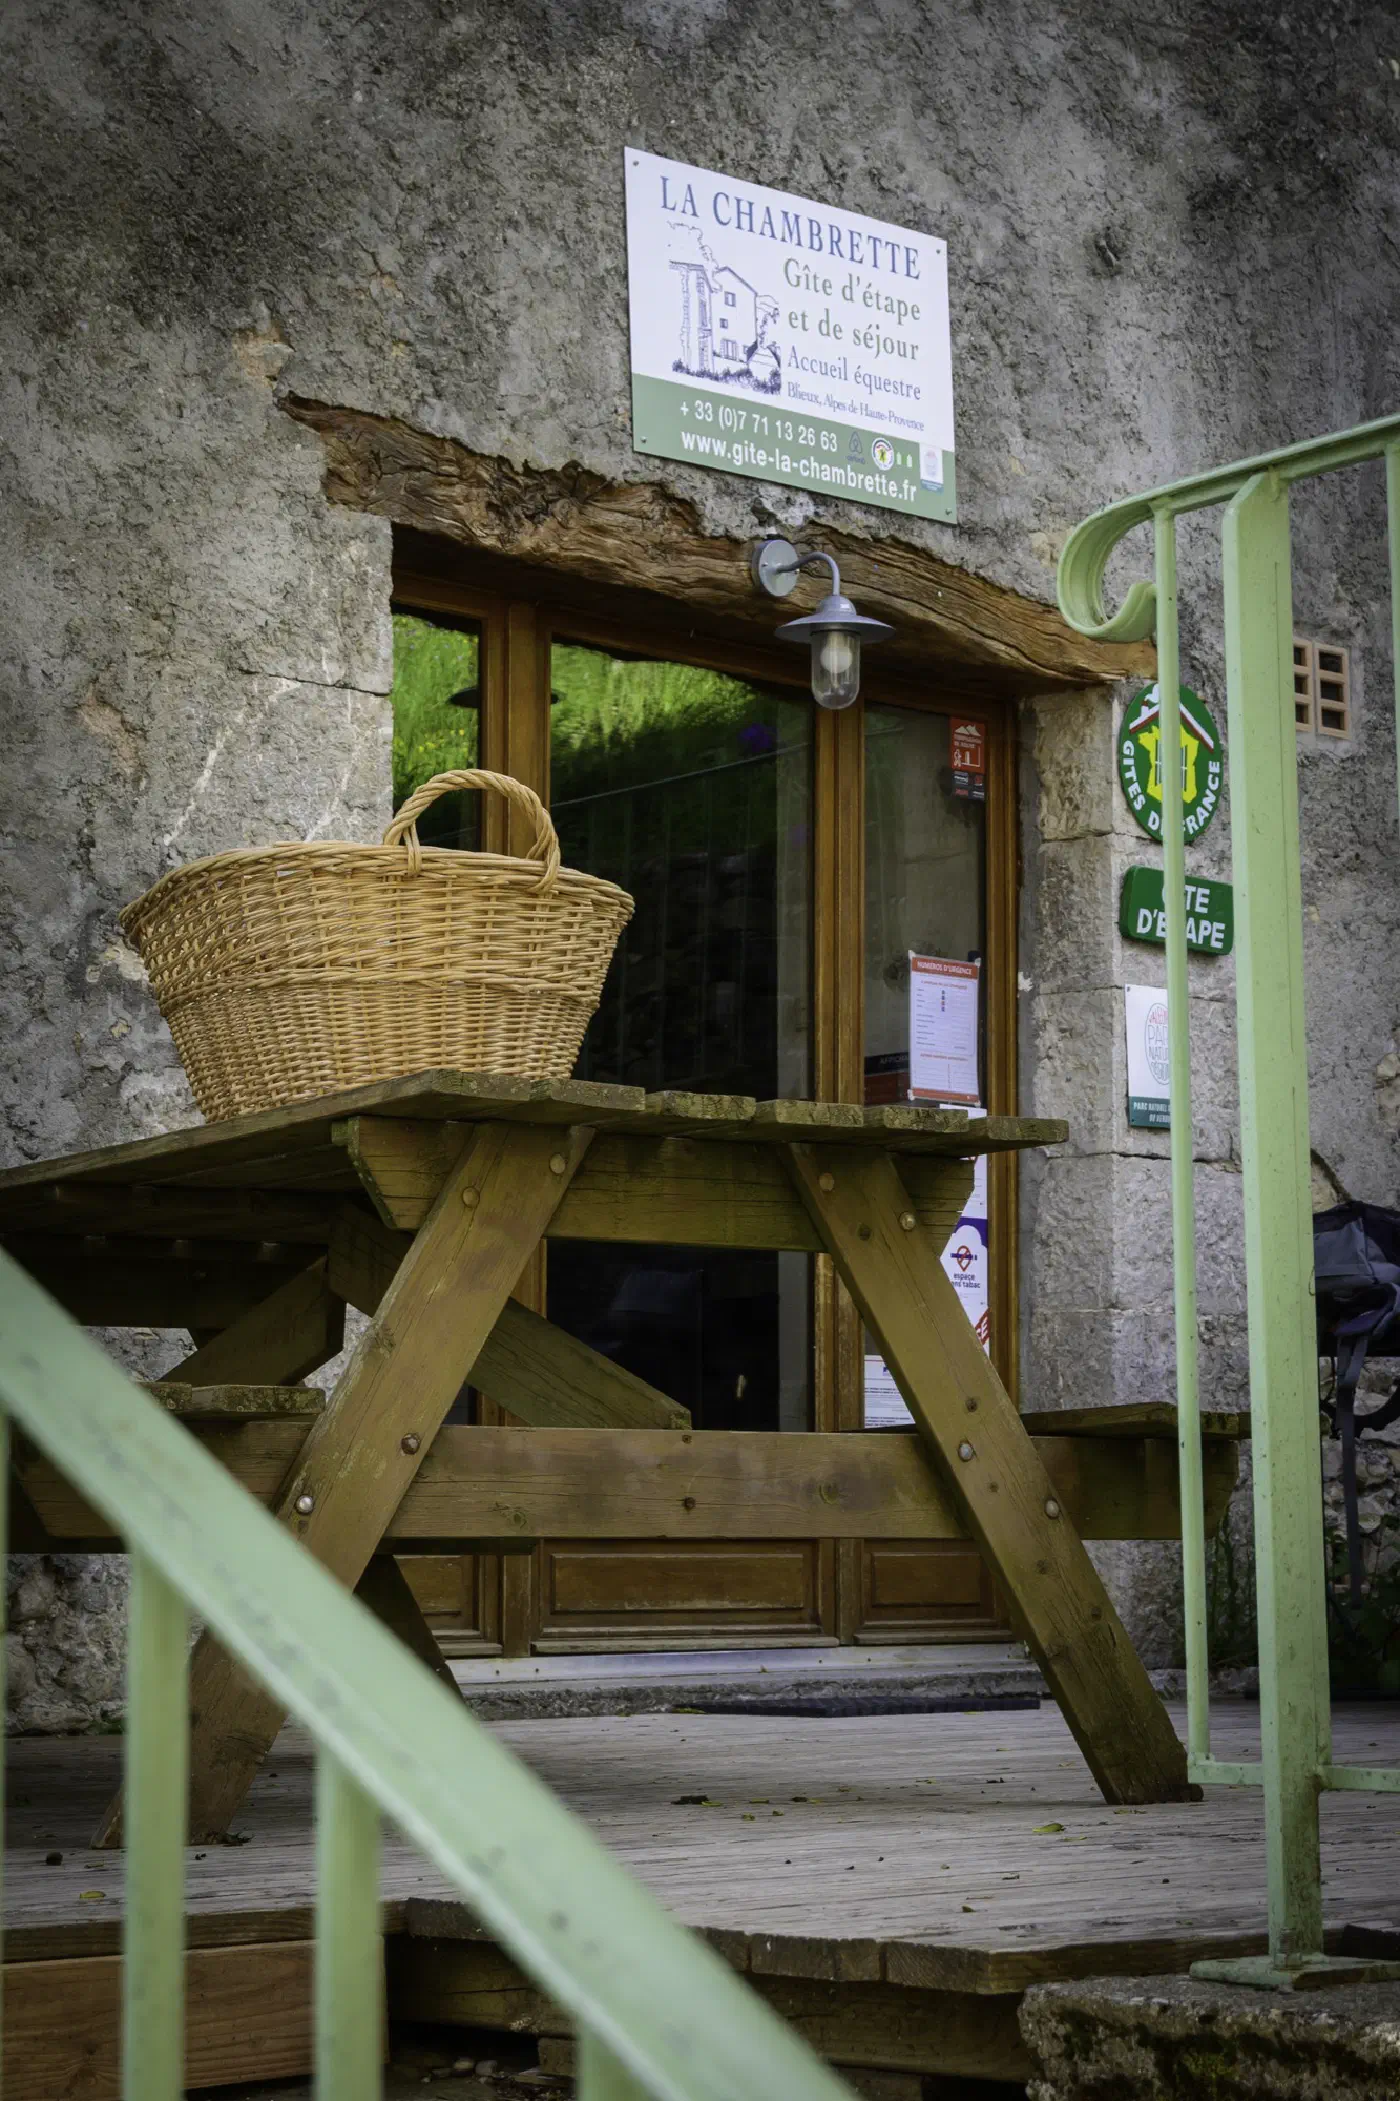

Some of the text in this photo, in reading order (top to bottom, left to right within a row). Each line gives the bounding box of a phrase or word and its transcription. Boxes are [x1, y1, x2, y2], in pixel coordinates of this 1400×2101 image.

[660, 175, 921, 280] LA CHAMBRETTE
[784, 257, 921, 326] Gîte d'étape
[788, 307, 919, 360] et de séjour
[787, 345, 921, 401] Accueil équestre
[694, 399, 713, 422] 33
[718, 404, 747, 432] (0)7
[752, 414, 769, 436] 71
[776, 420, 793, 441] 13
[798, 425, 816, 446] 26
[820, 431, 838, 452] 63
[823, 393, 847, 413] Alpes
[848, 399, 859, 415] de
[681, 431, 917, 503] www.gite-la-chambrette.fr
[1122, 740, 1220, 836] GITES D RANCE
[1136, 908, 1226, 949] D'EAPE
